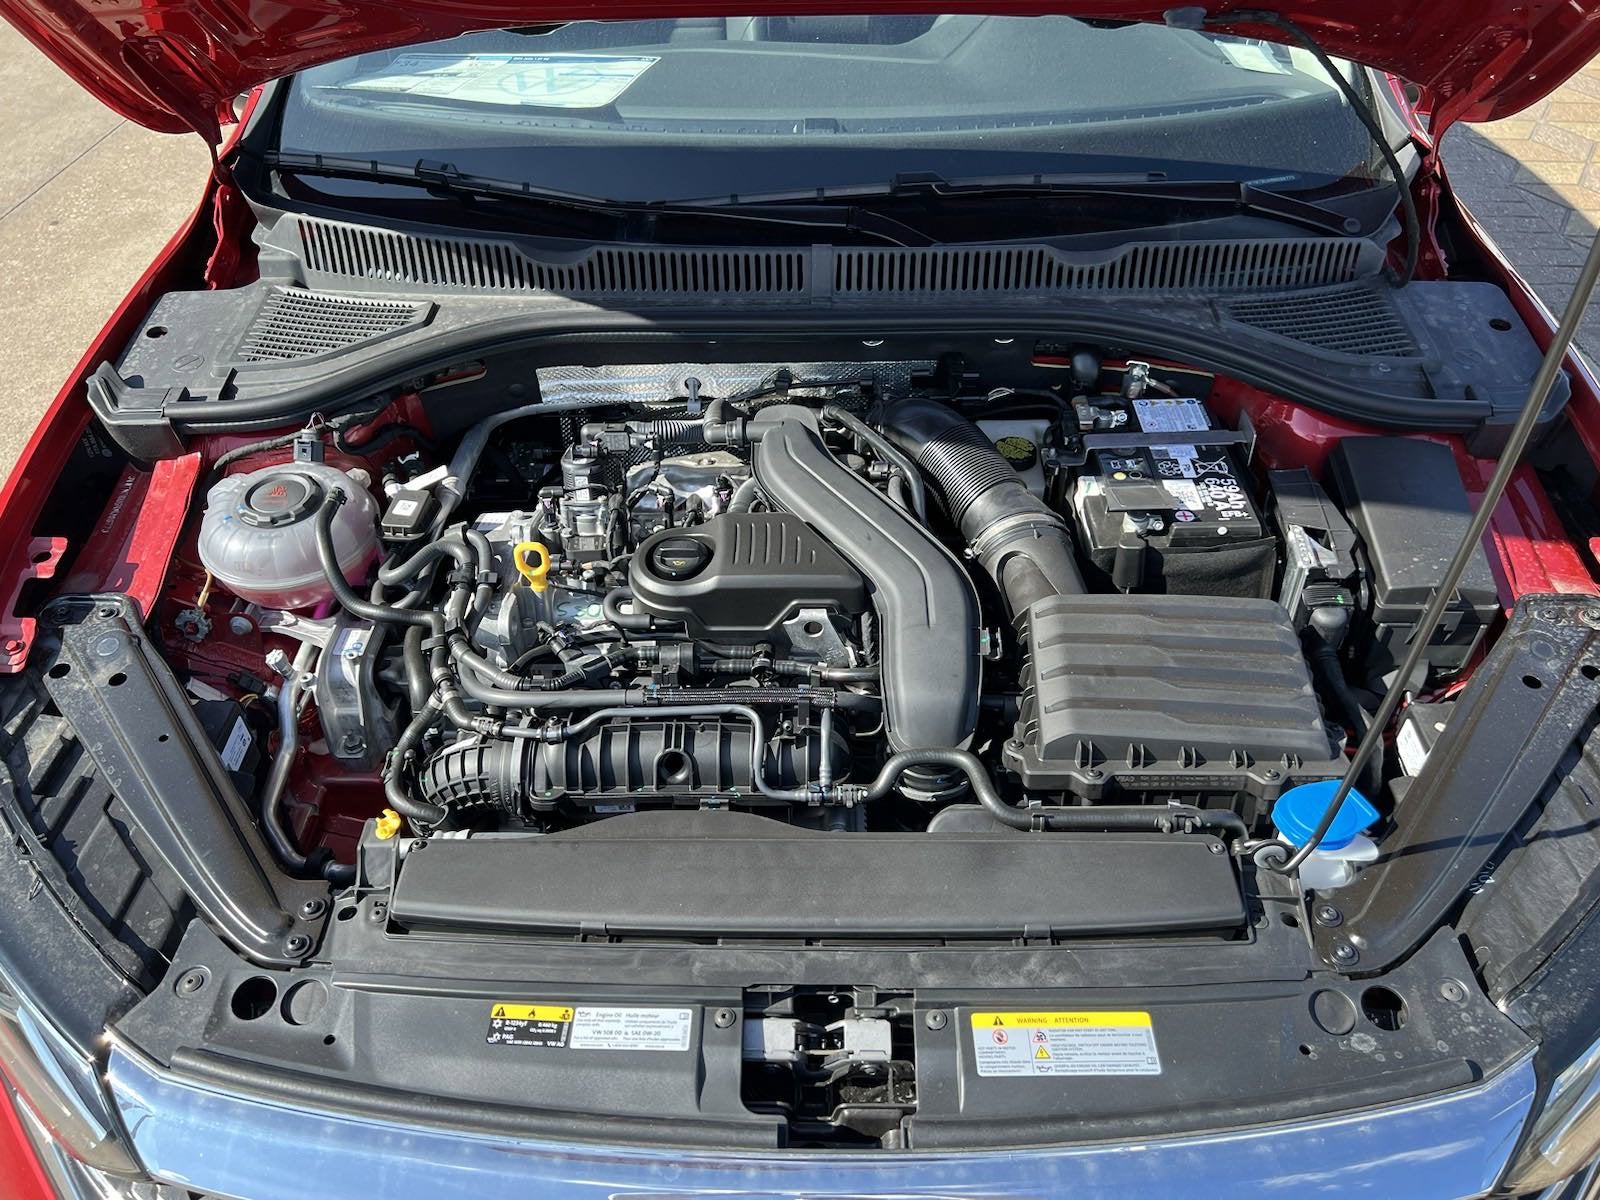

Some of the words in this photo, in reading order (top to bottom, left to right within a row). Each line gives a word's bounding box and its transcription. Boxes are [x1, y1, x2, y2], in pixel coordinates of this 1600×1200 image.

[1204, 477, 1227, 499] 640
[1212, 500, 1231, 511] A
[595, 1011, 614, 1019] Engine
